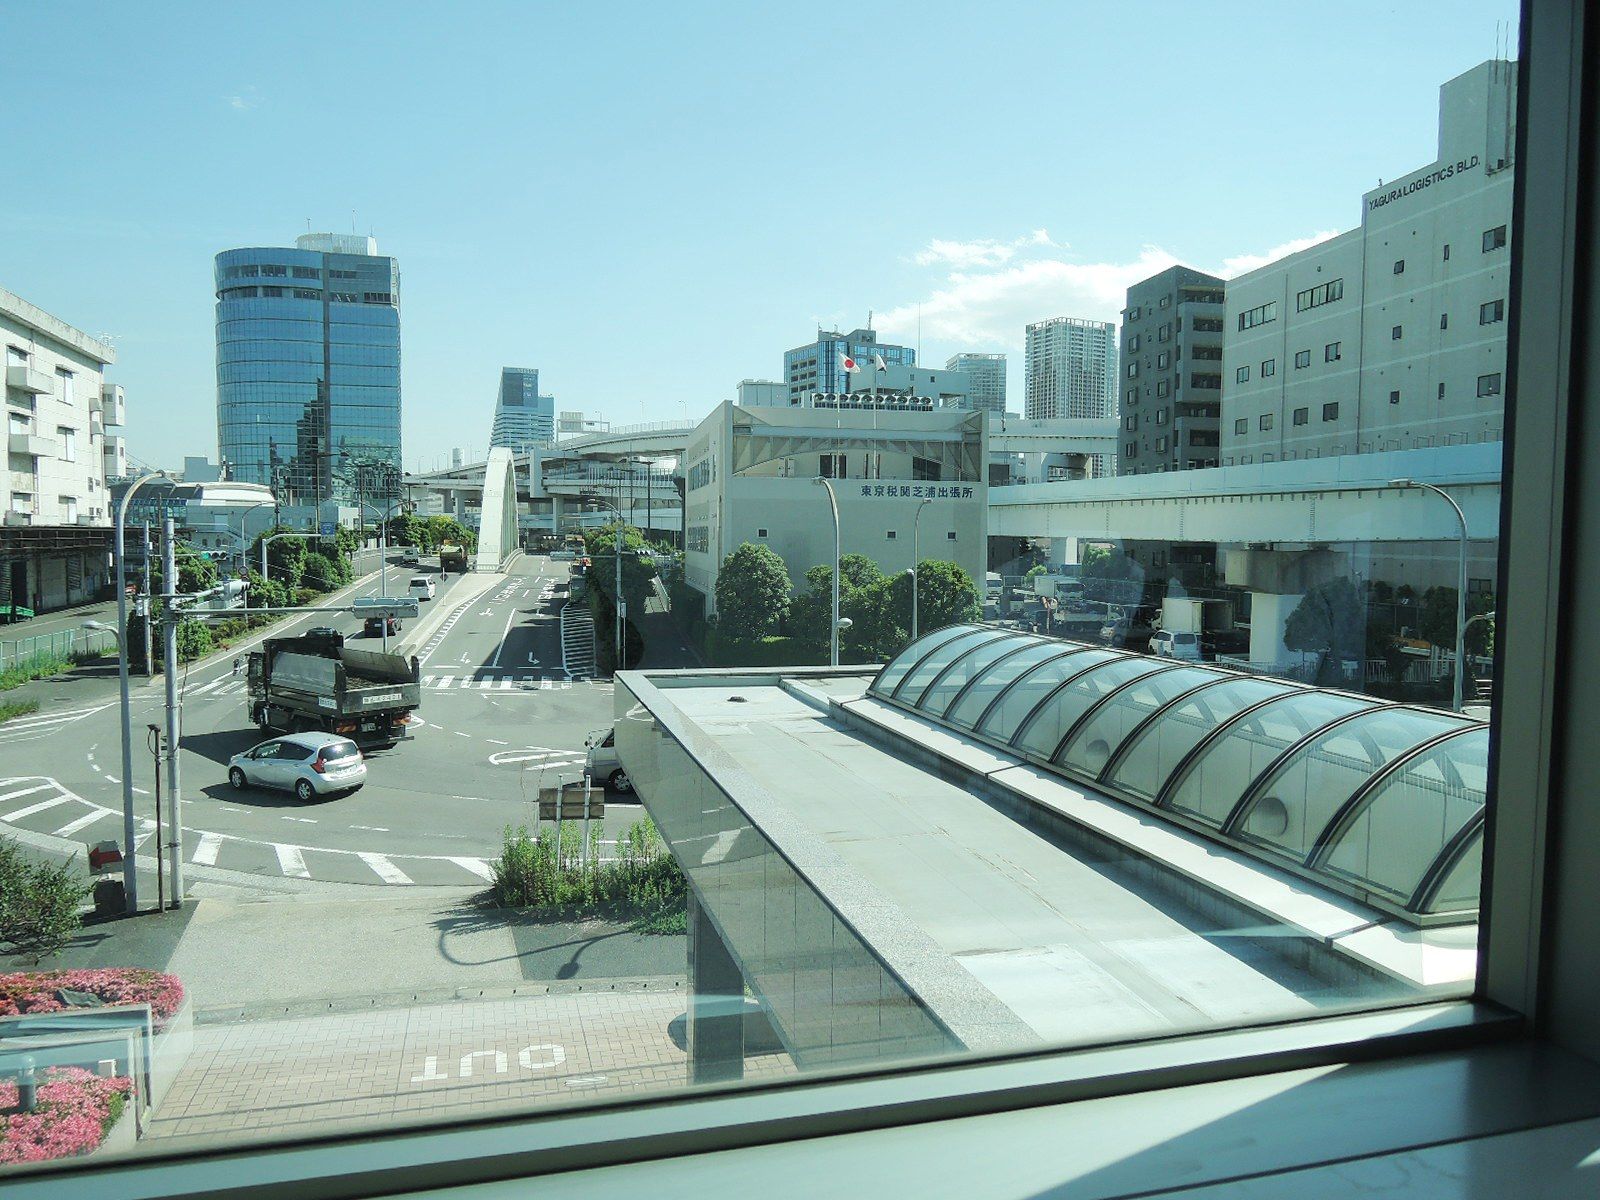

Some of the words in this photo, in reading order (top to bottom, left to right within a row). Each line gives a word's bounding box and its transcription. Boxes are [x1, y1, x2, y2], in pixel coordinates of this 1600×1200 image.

[1457, 155, 1481, 174] BLD.
[861, 484, 973, 499] 東京税関芝浦出張所
[410, 1043, 567, 1083] OUT
